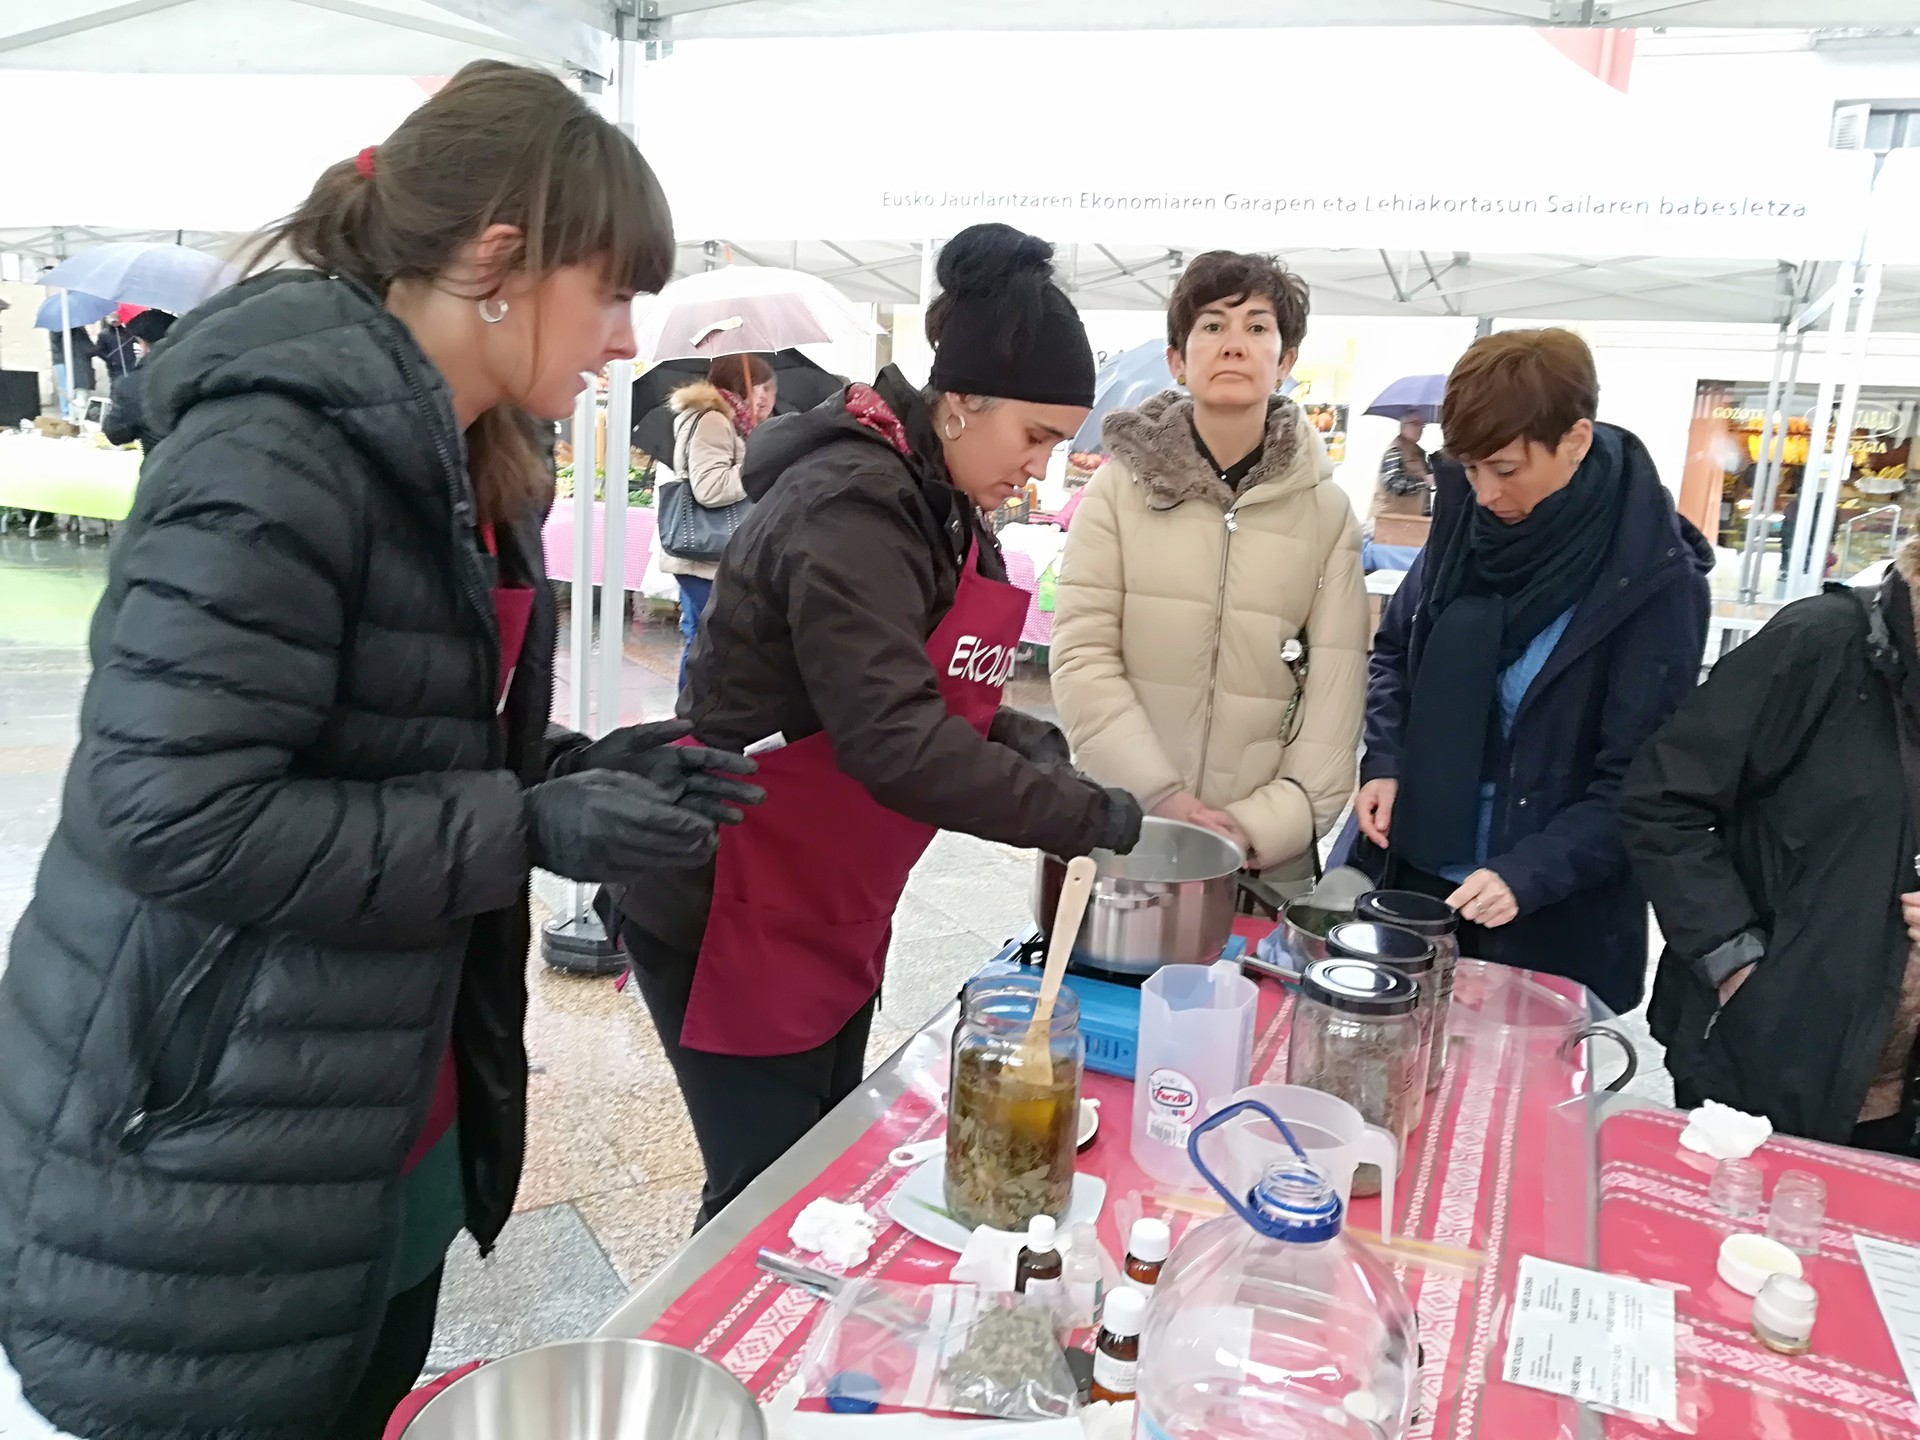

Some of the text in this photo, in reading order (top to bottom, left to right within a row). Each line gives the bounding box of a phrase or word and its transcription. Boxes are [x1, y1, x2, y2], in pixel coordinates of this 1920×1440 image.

[882, 190, 1806, 218] Eusko Jaurlaritzaren Ekonomiaren Garapen eta Lehiakortasun Sailaren babesletza
